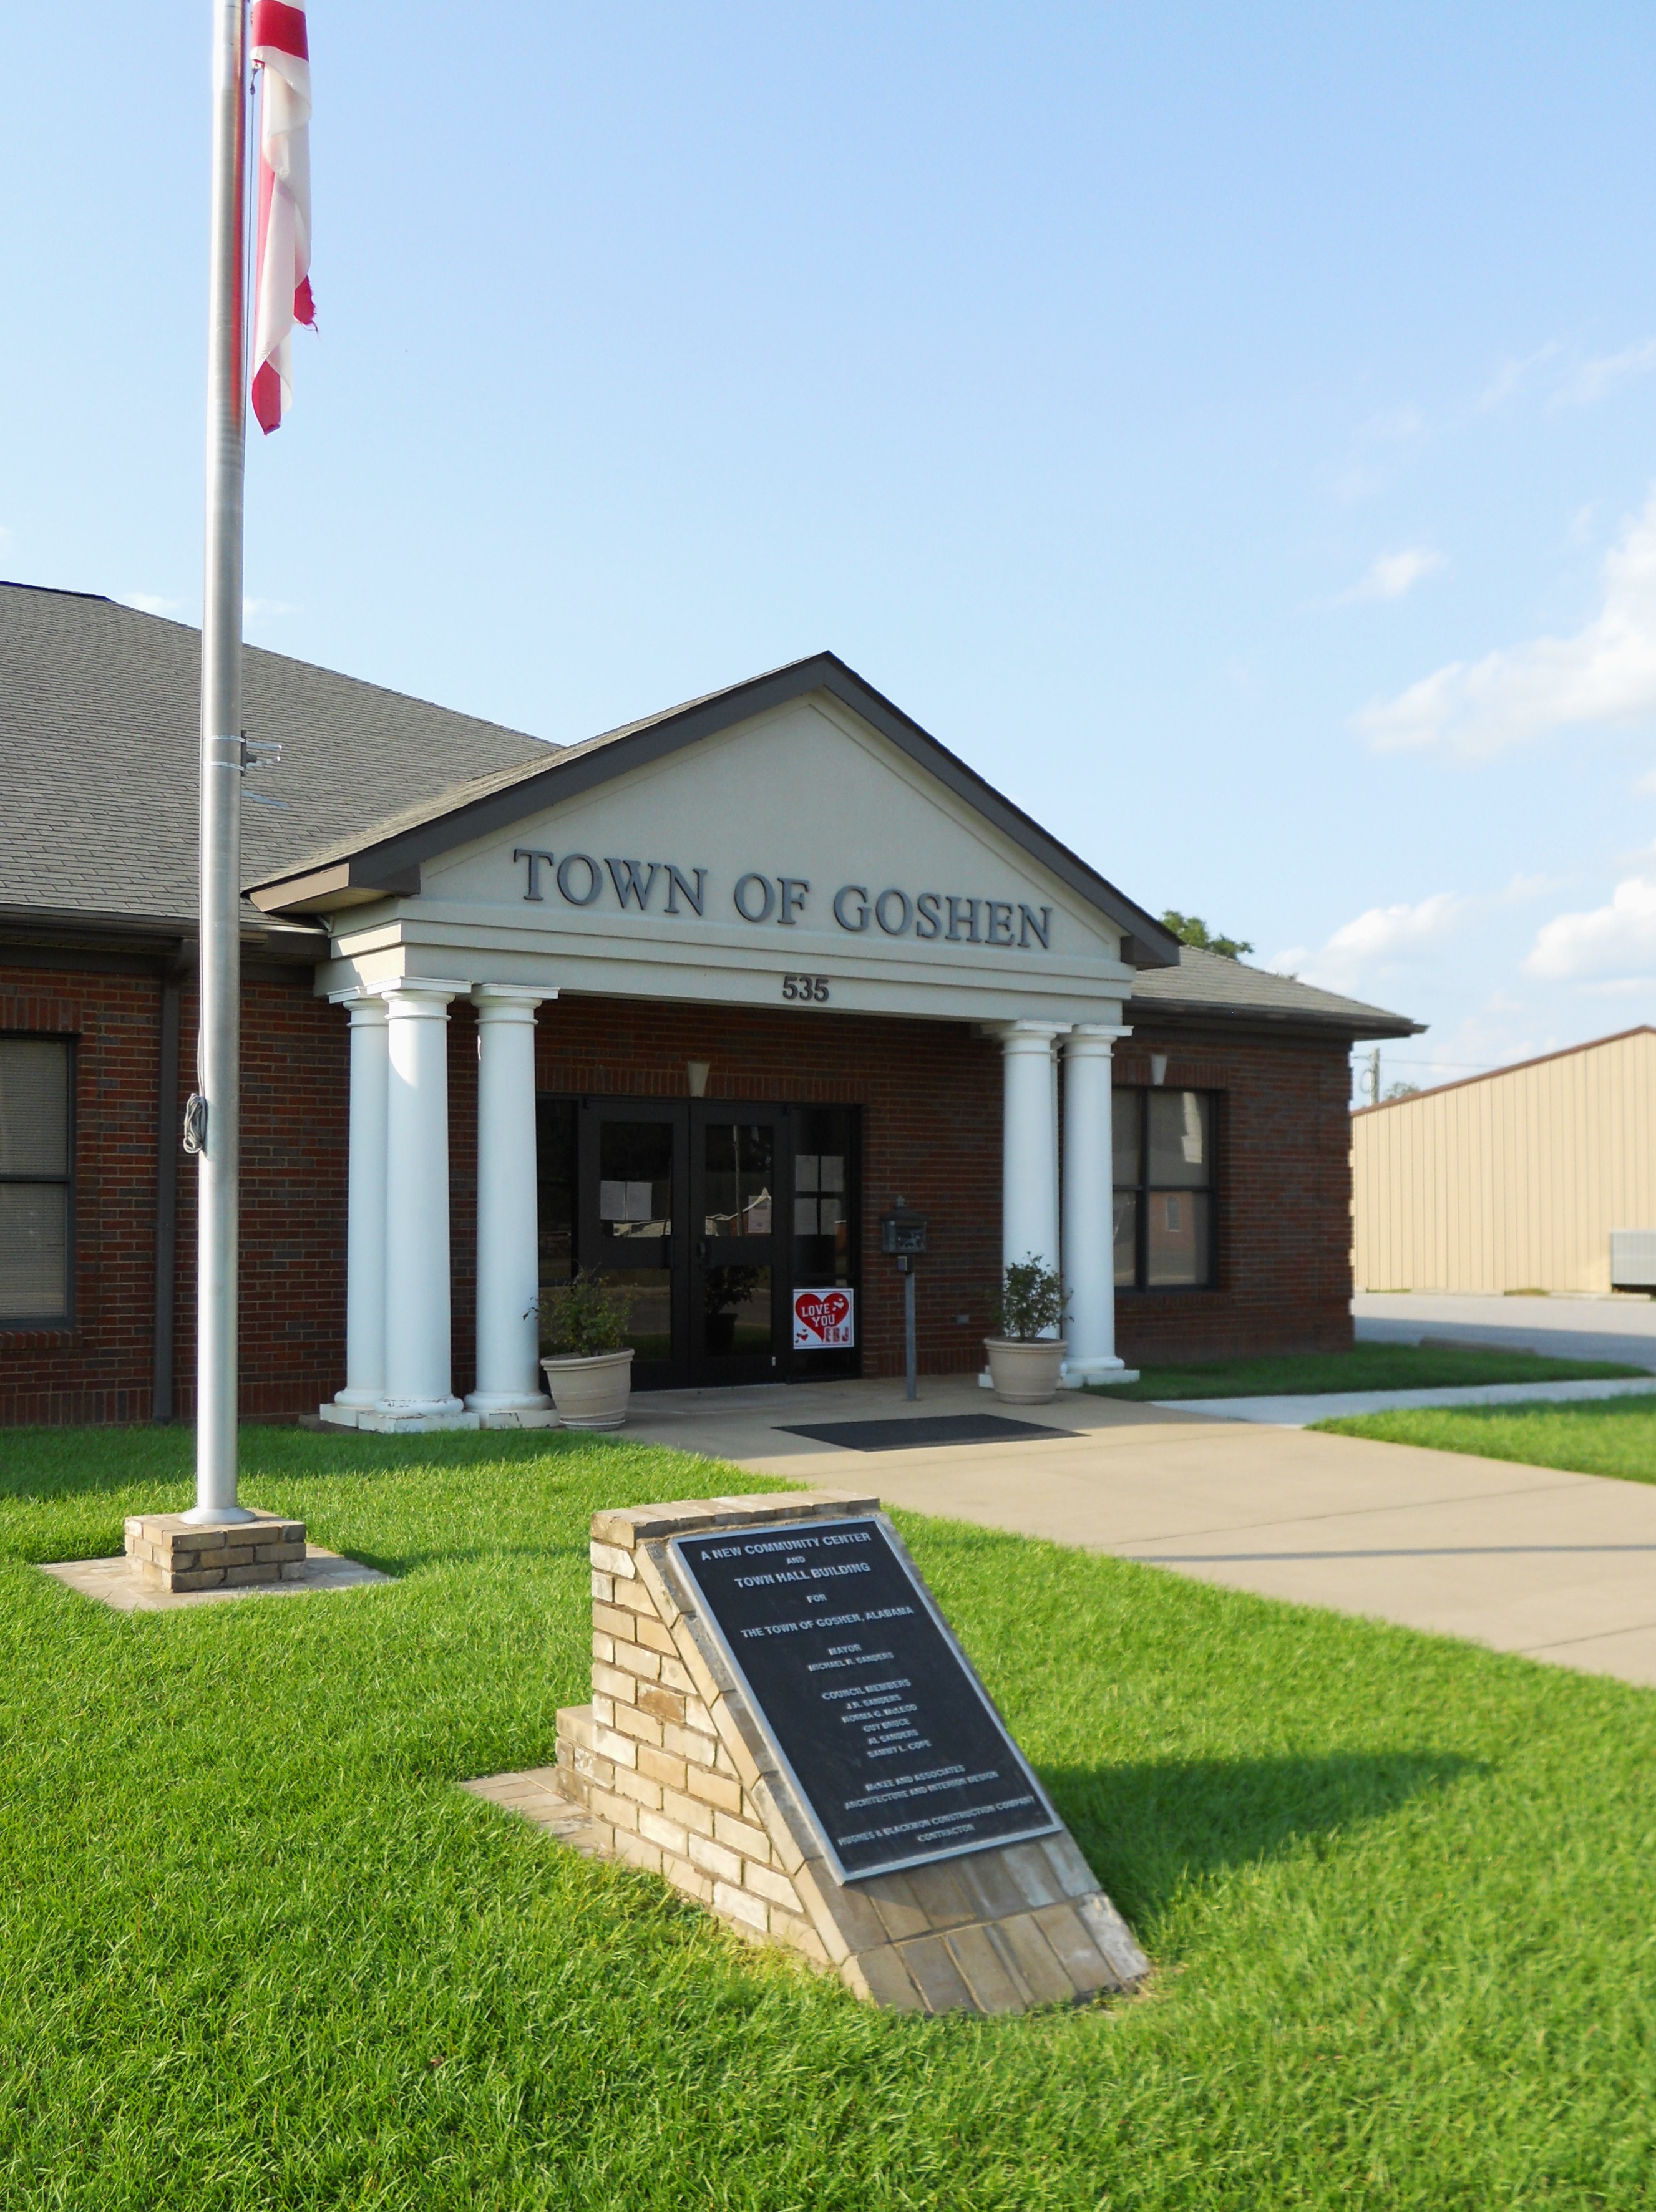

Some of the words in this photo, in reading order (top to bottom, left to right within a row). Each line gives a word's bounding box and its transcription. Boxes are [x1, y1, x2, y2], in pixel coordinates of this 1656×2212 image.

[513, 848, 707, 916] TOWN
[734, 873, 810, 924] OF
[833, 885, 1053, 949] GOSHEN
[782, 975, 830, 1002] 535
[801, 1303, 830, 1317] LOVE
[812, 1314, 835, 1327] YOU
[701, 1551, 711, 1561] A
[712, 1547, 741, 1560] NEW
[744, 1538, 819, 1555] COMMUNITY
[822, 1532, 872, 1546] CENTER
[786, 1556, 806, 1564] AND
[734, 1574, 775, 1588] TOWN
[776, 1570, 810, 1583] HALL
[811, 1562, 871, 1579] BUILDING
[807, 1594, 827, 1603] FOR
[741, 1627, 764, 1638] THE
[765, 1623, 799, 1635] TOWN
[799, 1621, 814, 1630] OF
[817, 1614, 864, 1627] GOSHEN,
[866, 1606, 914, 1620] ALABAMA
[828, 1644, 862, 1656] MAYOR
[808, 1660, 846, 1672] MICHAEL
[856, 1652, 894, 1664] SANDERS
[822, 1687, 865, 1700] COUNCIL
[865, 1679, 912, 1693] MEMBERS
[863, 1694, 902, 1707] SANDERS
[842, 1712, 874, 1724] NORMA
[884, 1704, 918, 1715] McLEOD
[863, 1724, 880, 1732] GUY
[881, 1718, 911, 1729] BRUCE
[868, 1737, 880, 1745] AL
[880, 1729, 919, 1742] SANDERS
[867, 1747, 898, 1758] SAMMY
[908, 1740, 932, 1750] COPE
[895, 1776, 913, 1786] AND
[915, 1765, 965, 1782] ASSOCIATES
[845, 1790, 908, 1810] ARCHITECTURE
[910, 1786, 927, 1796] AND
[927, 1778, 967, 1792] INTERIOR
[967, 1771, 998, 1783] DESIGN
[838, 1831, 875, 1846] HUGHES
[875, 1830, 883, 1838] &
[883, 1819, 931, 1835] BLACKMON
[932, 1803, 996, 1825] CONSTRUCTION
[996, 1795, 1035, 1810] COMPANY
[917, 1824, 975, 1842] CONTRACTOR
